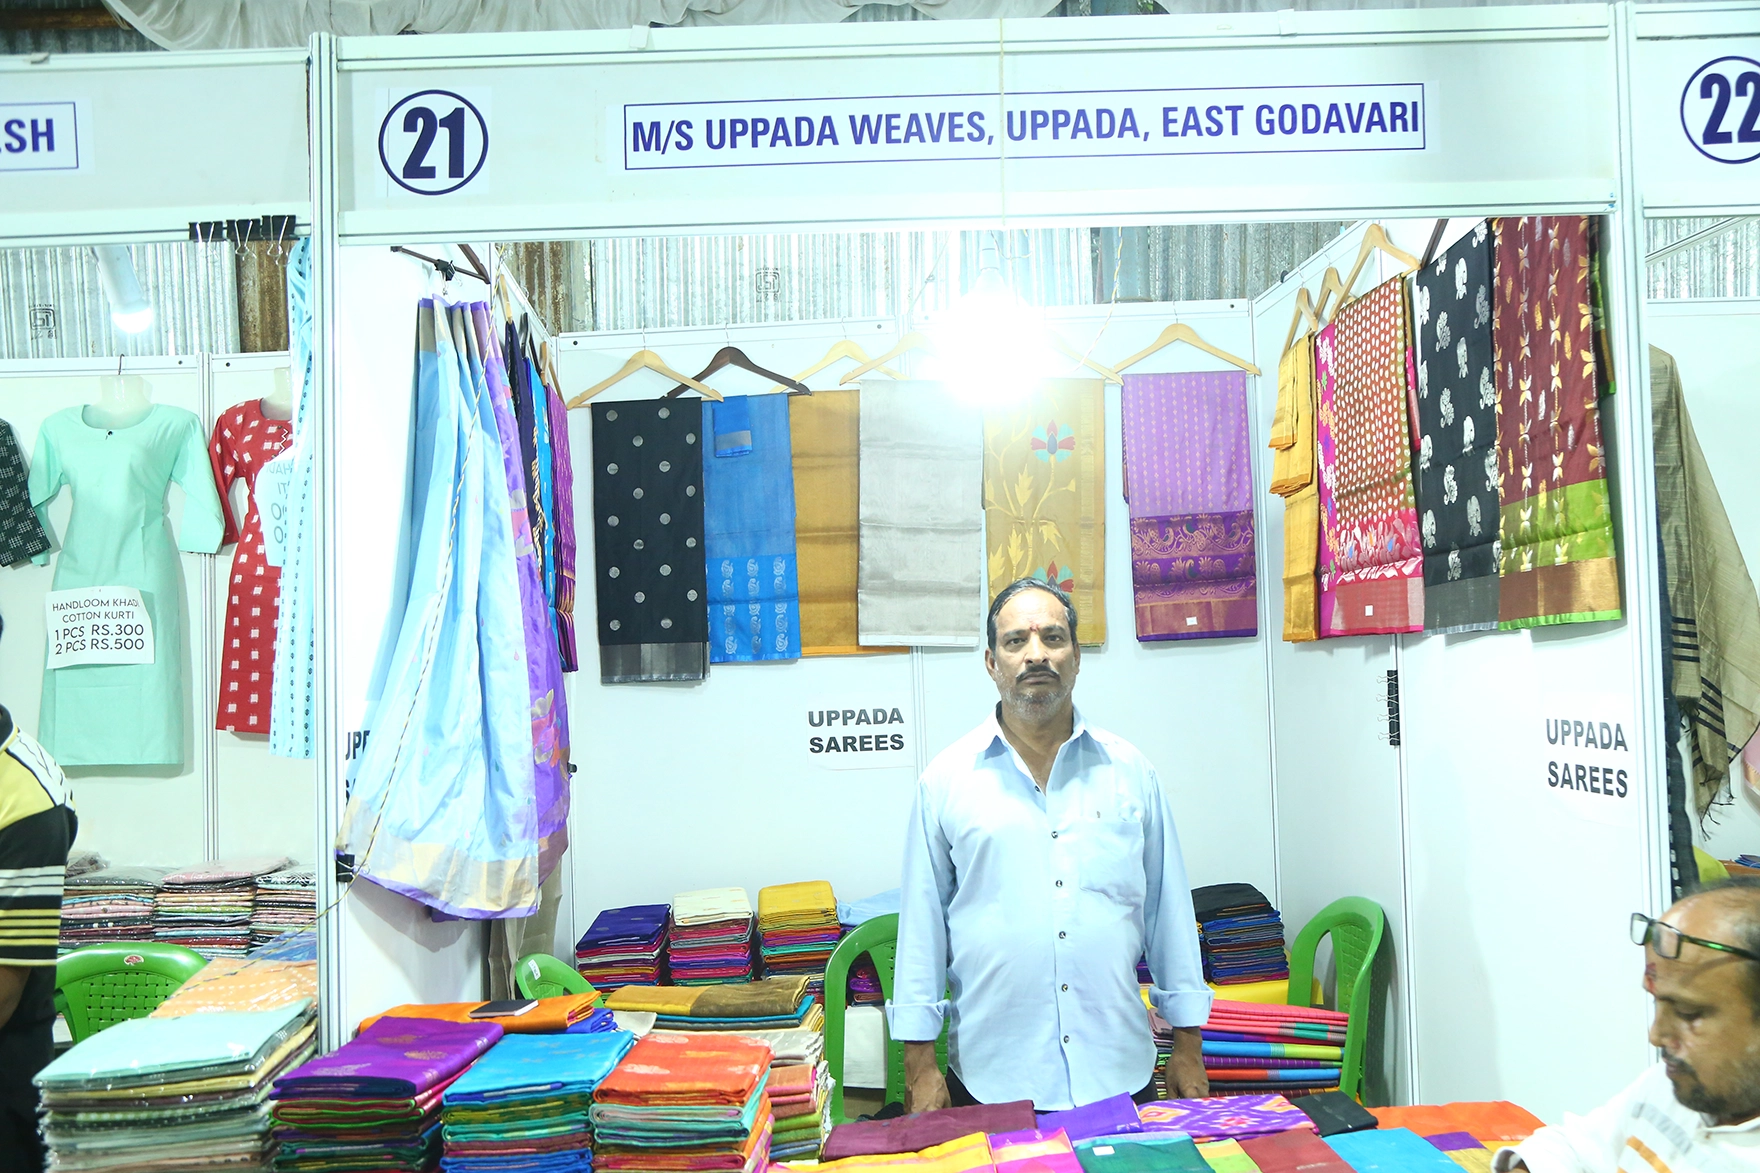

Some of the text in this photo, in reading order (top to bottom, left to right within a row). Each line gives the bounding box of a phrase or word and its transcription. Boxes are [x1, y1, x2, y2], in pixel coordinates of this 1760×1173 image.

[1700, 71, 1760, 145] 22
[0, 118, 55, 153] SH
[632, 101, 1419, 155] M/S UPPADA WEAVES, UPPADA, EAST GODAVARI
[403, 106, 465, 179] 21
[52, 598, 110, 612] HANDLOOM
[62, 610, 134, 623] COTTON KURTI
[55, 624, 144, 641] 1 PCS RS.300
[55, 638, 145, 655] 2 PCS RS.500
[808, 707, 905, 727] UPPADA
[809, 734, 905, 754] SAREES
[1546, 718, 1629, 752] UPPADA
[1547, 760, 1629, 798] SAREES
